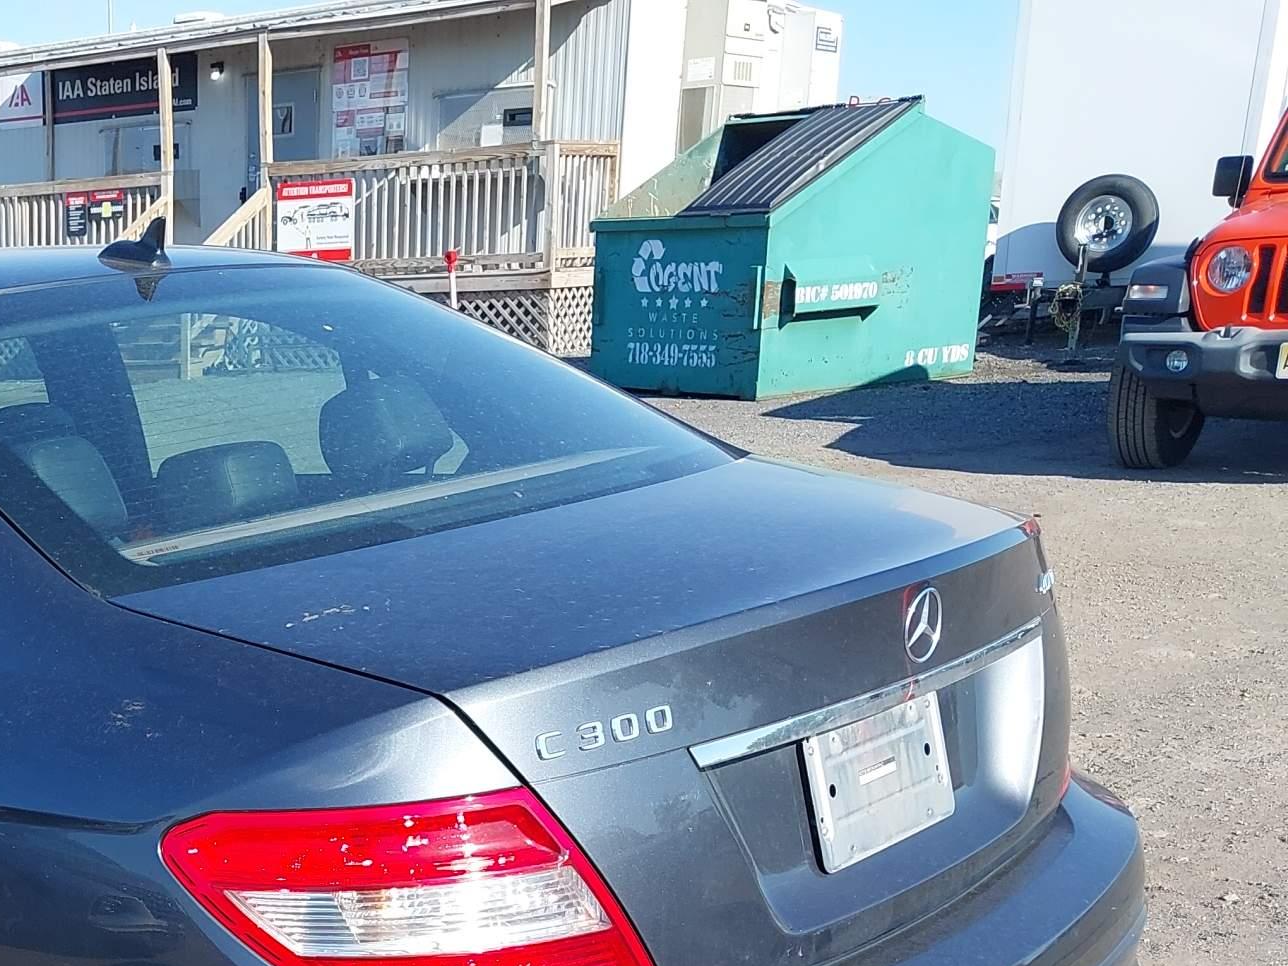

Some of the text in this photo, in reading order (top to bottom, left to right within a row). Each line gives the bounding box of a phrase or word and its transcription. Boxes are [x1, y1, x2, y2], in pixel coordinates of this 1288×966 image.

[59, 67, 179, 100] IAA Staten Islad
[795, 284, 829, 304] BIC#
[648, 312, 698, 324] WASTE
[627, 327, 719, 341] SOLUTIONS
[627, 342, 716, 368] 718-349-7555
[904, 343, 970, 368] 8 CU YDS
[535, 704, 674, 761] C 300
